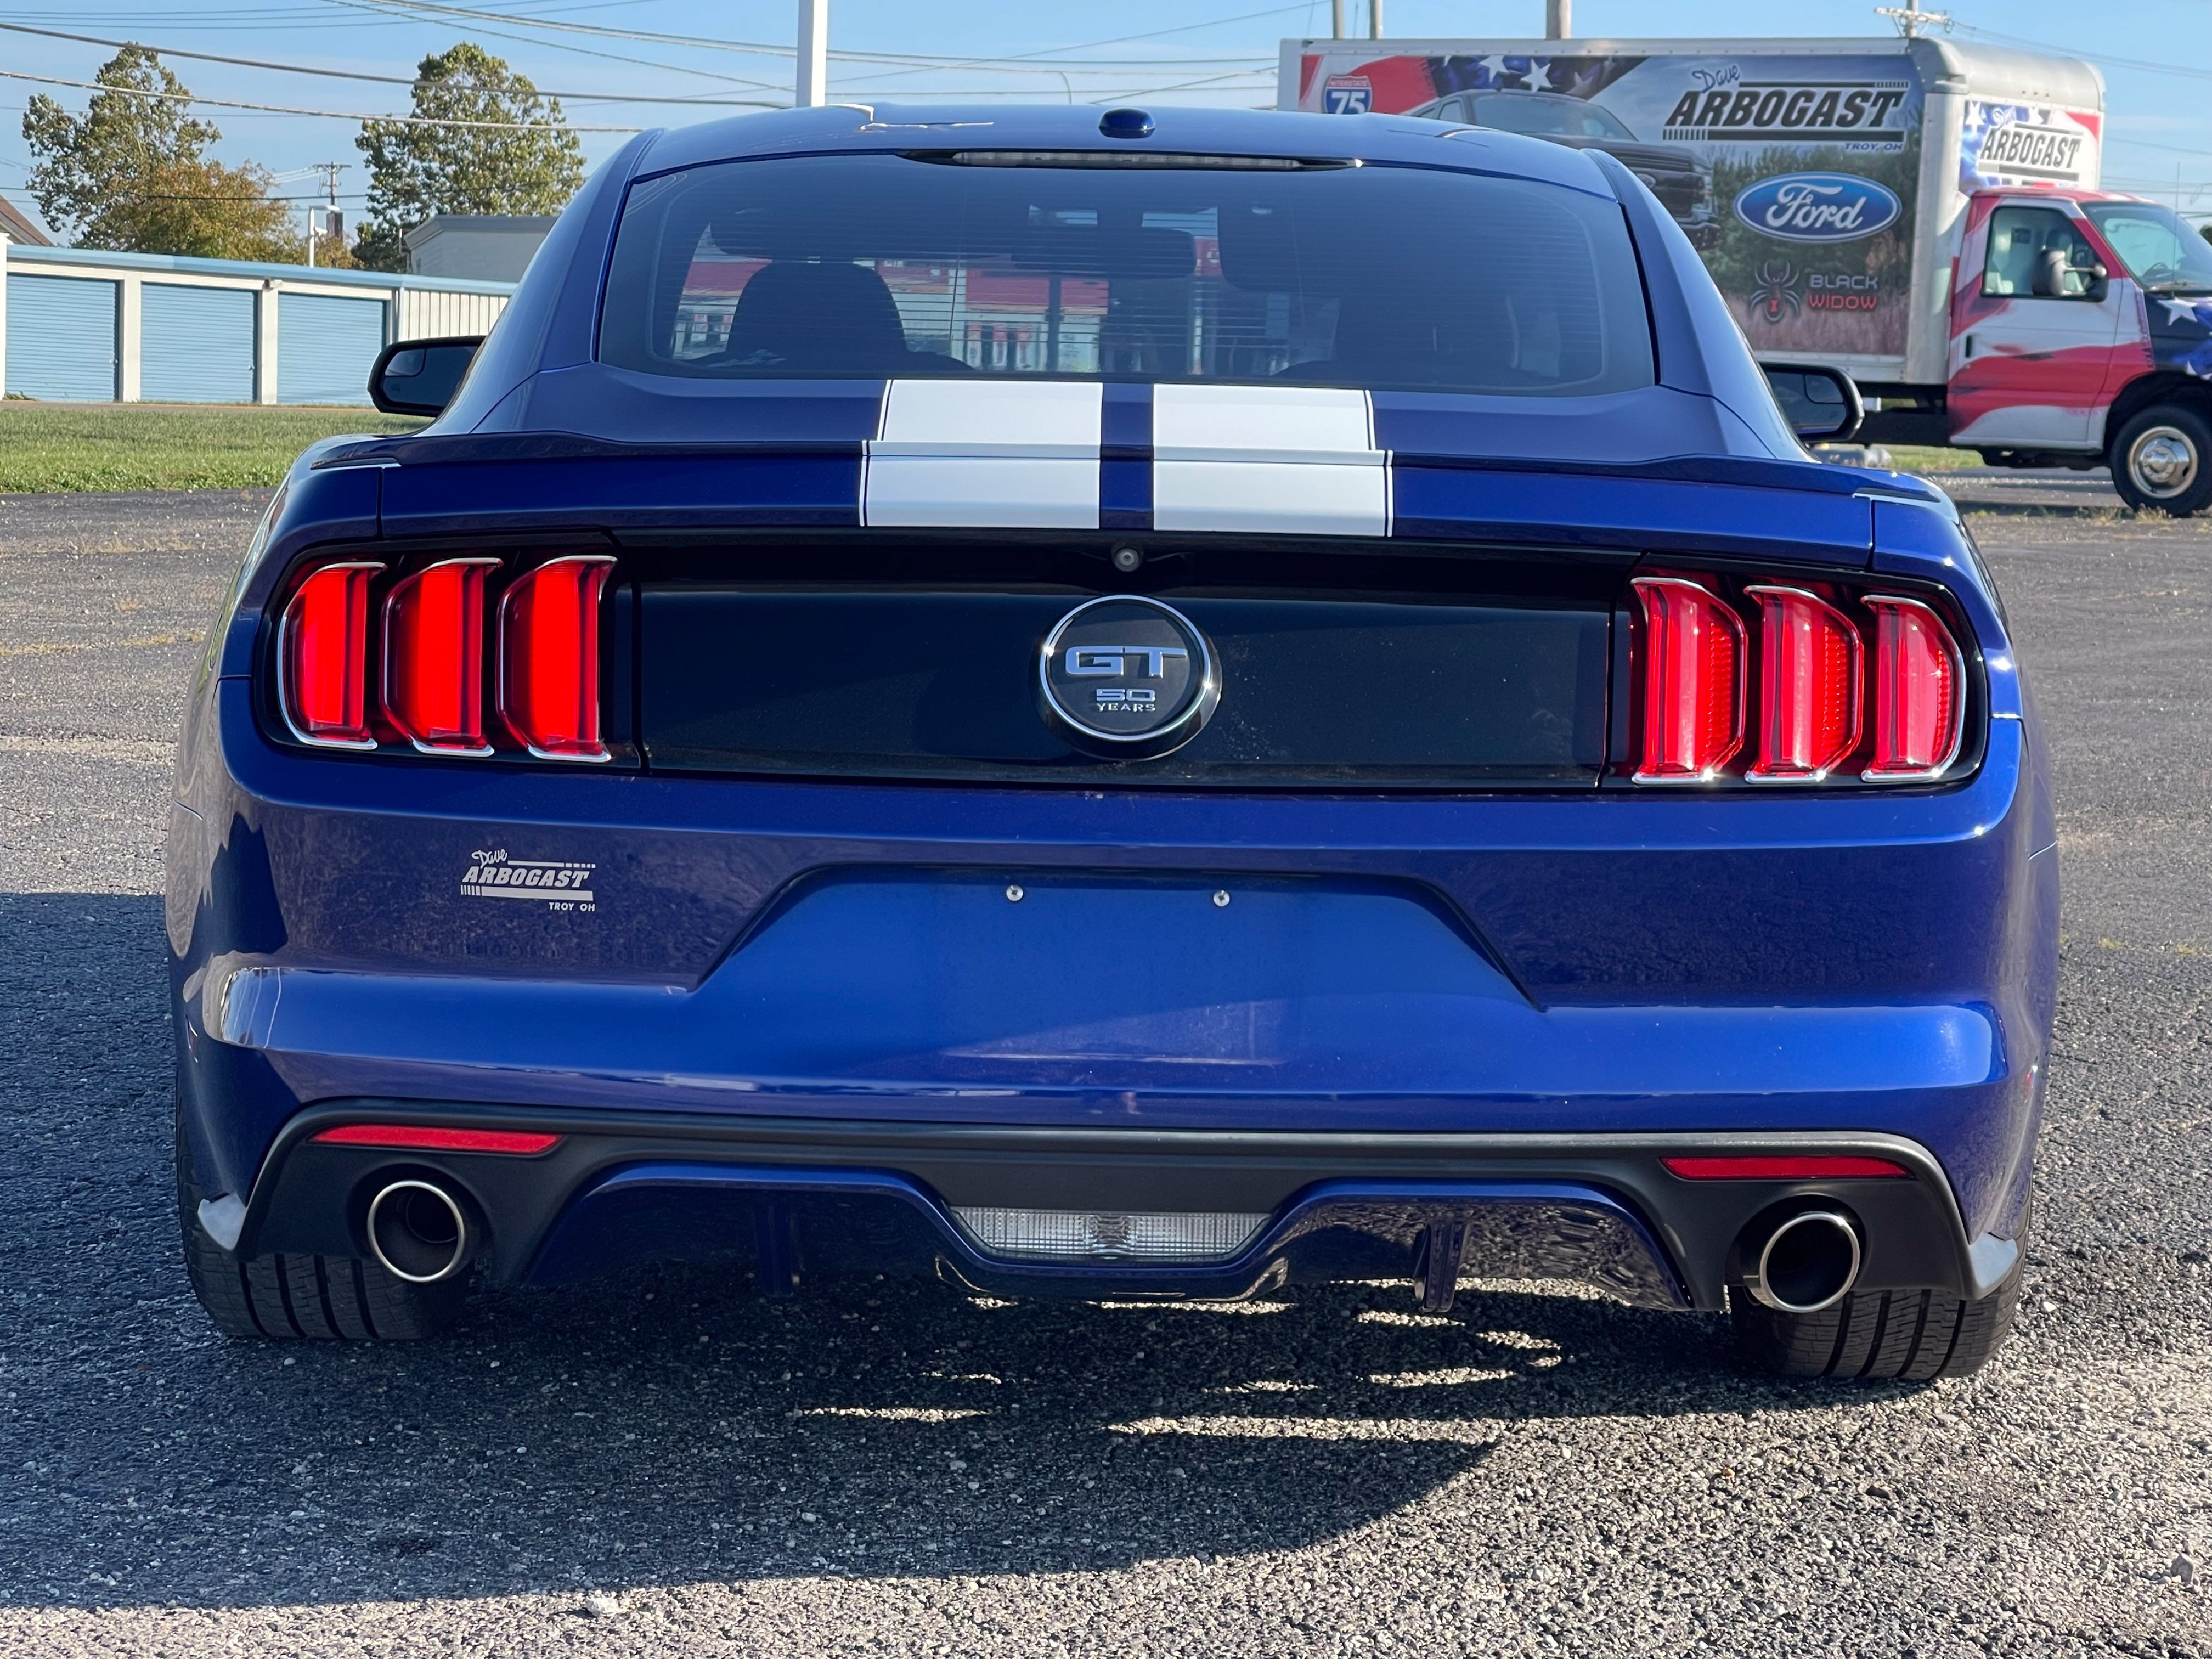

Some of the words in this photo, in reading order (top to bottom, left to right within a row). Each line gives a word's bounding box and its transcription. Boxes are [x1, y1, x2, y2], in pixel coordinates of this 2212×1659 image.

[1691, 65, 1740, 94] Dave
[1331, 91, 1365, 115] 75
[1664, 91, 1906, 127] ARBOGAST
[1979, 128, 2082, 169] ARBOGAST
[1765, 183, 1867, 229] Ford
[1810, 274, 1878, 290] BLACK
[1808, 294, 1878, 310] WIDOW
[1065, 645, 1188, 678] GT
[1096, 689, 1156, 702] 50
[1097, 702, 1156, 712] YEARS
[471, 849, 507, 869] Dave
[462, 866, 590, 888] ARBOGAST
[549, 902, 575, 911] TROY
[579, 904, 595, 912] OH
